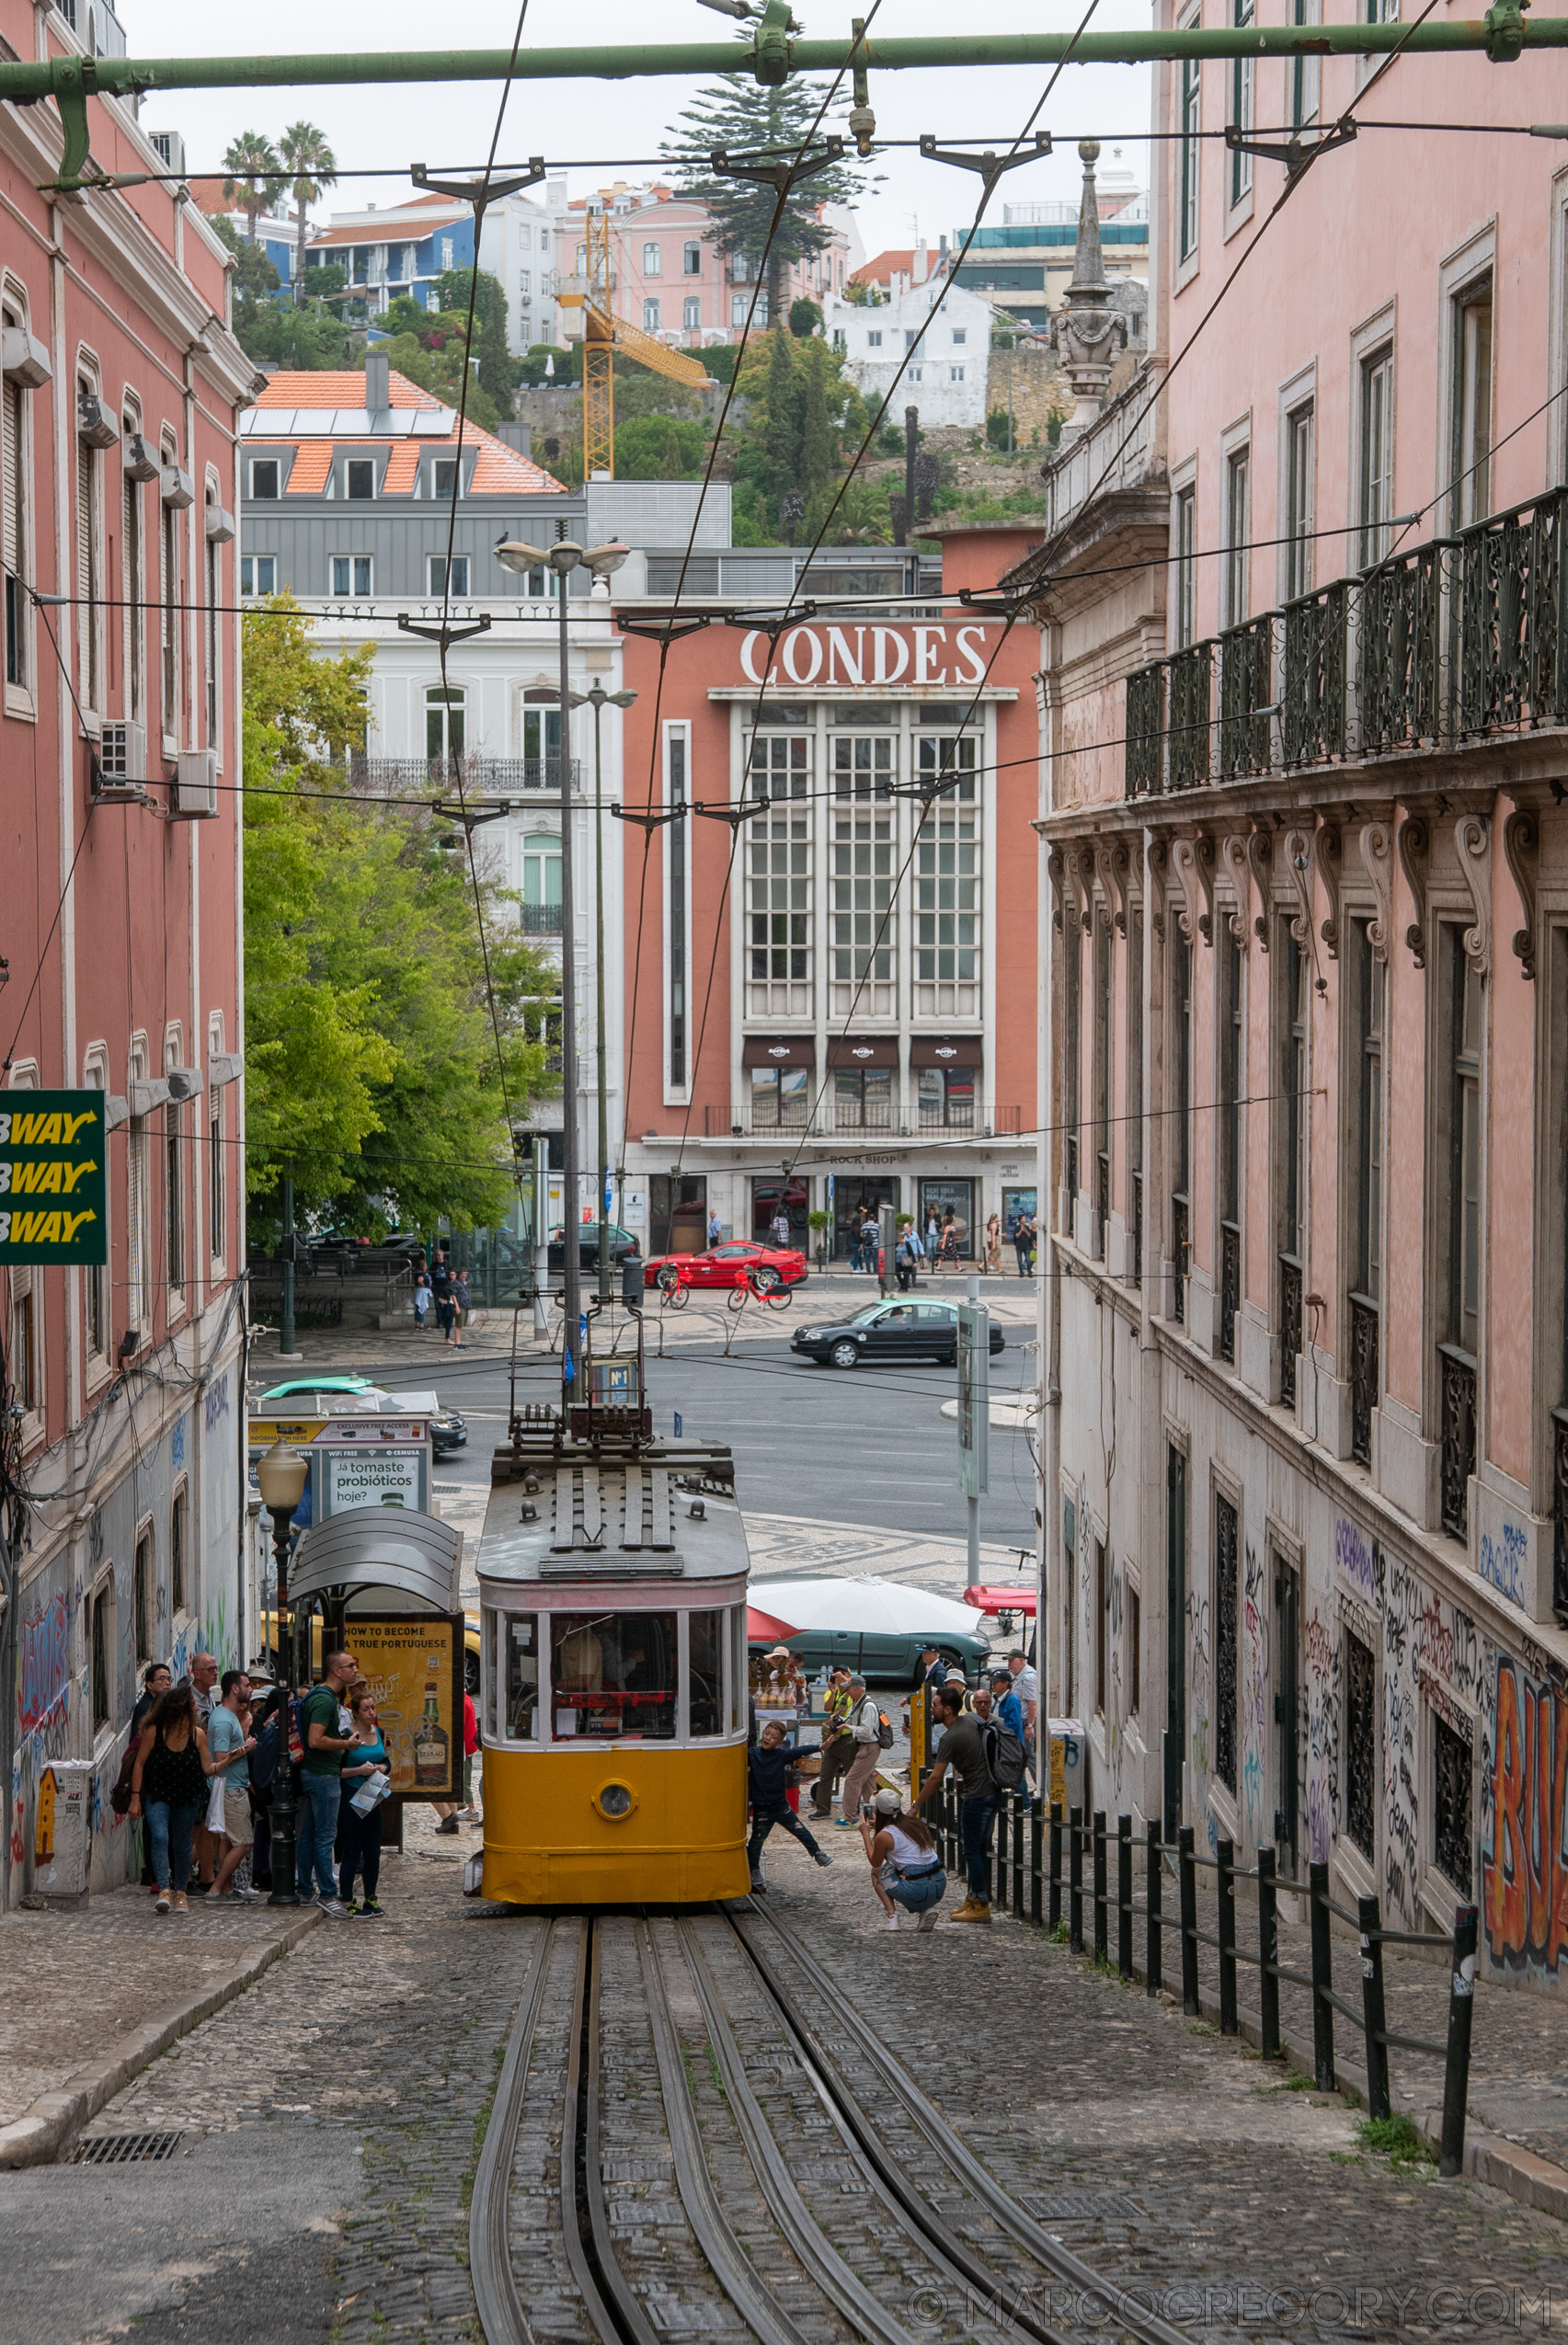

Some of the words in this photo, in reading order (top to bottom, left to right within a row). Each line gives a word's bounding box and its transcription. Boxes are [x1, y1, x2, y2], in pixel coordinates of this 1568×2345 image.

[740, 625, 987, 684] CONDES
[830, 1155, 863, 1164] ROCK
[865, 1155, 897, 1164] SHOP
[623, 1369, 627, 1385] 1
[337, 1462, 348, 1471] Já
[350, 1461, 405, 1473] tomaste
[337, 1475, 412, 1488] probióticos
[337, 1491, 367, 1503] hoje?
[344, 1627, 367, 1636] HOW
[369, 1627, 382, 1636] TO
[384, 1627, 426, 1636] BECOME
[344, 1640, 351, 1648] A
[353, 1640, 379, 1648] TRUE
[381, 1640, 447, 1649] PORTUGUESE
